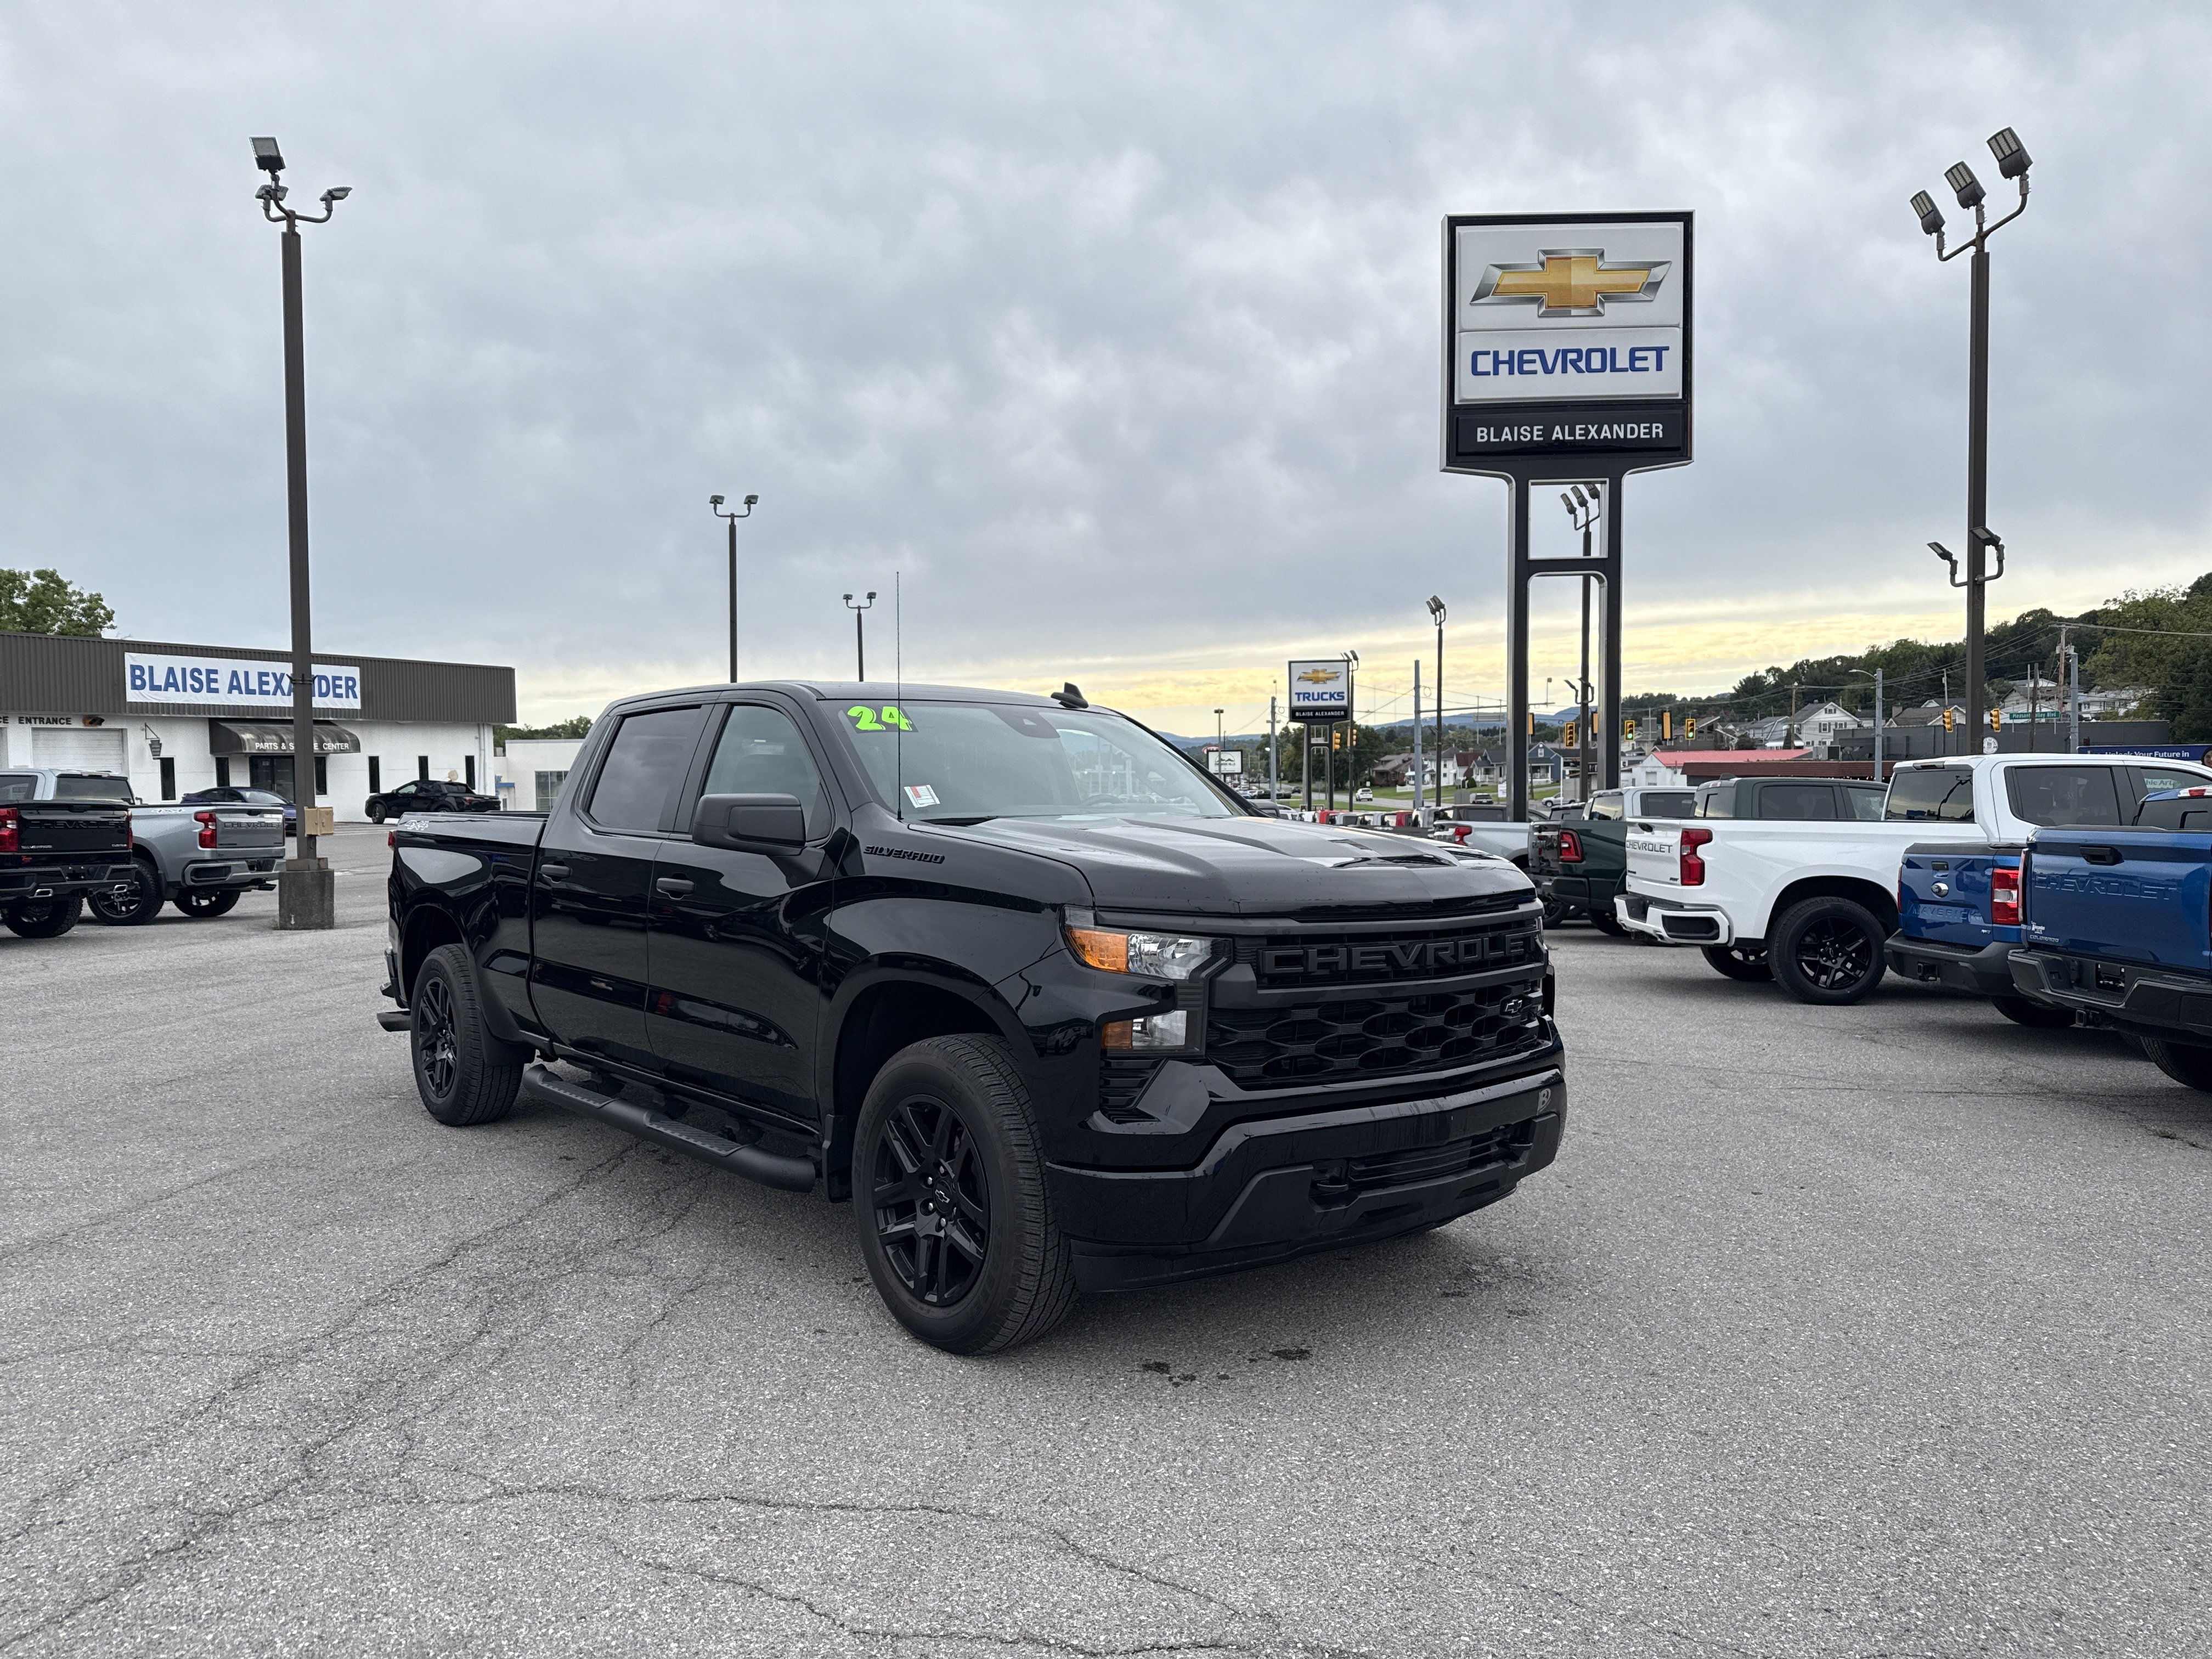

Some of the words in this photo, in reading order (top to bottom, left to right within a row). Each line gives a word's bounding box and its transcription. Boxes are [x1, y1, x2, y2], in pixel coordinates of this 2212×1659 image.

[1471, 346, 1669, 376] CHEVROLET
[1477, 425, 1544, 442] BLAISE
[1551, 423, 1663, 441] ALEXANDER
[129, 664, 219, 693] BLAISE
[227, 669, 358, 699] ALEXDER
[1295, 691, 1345, 702] TRUCKS
[18, 716, 72, 725] ENTRANCE
[848, 706, 912, 731] 24
[864, 845, 945, 864] SILVERADO
[1626, 840, 1673, 853] CHEVROLET
[2034, 876, 2177, 900] CHEVROLET
[1262, 932, 1540, 974] CHEVROLET
